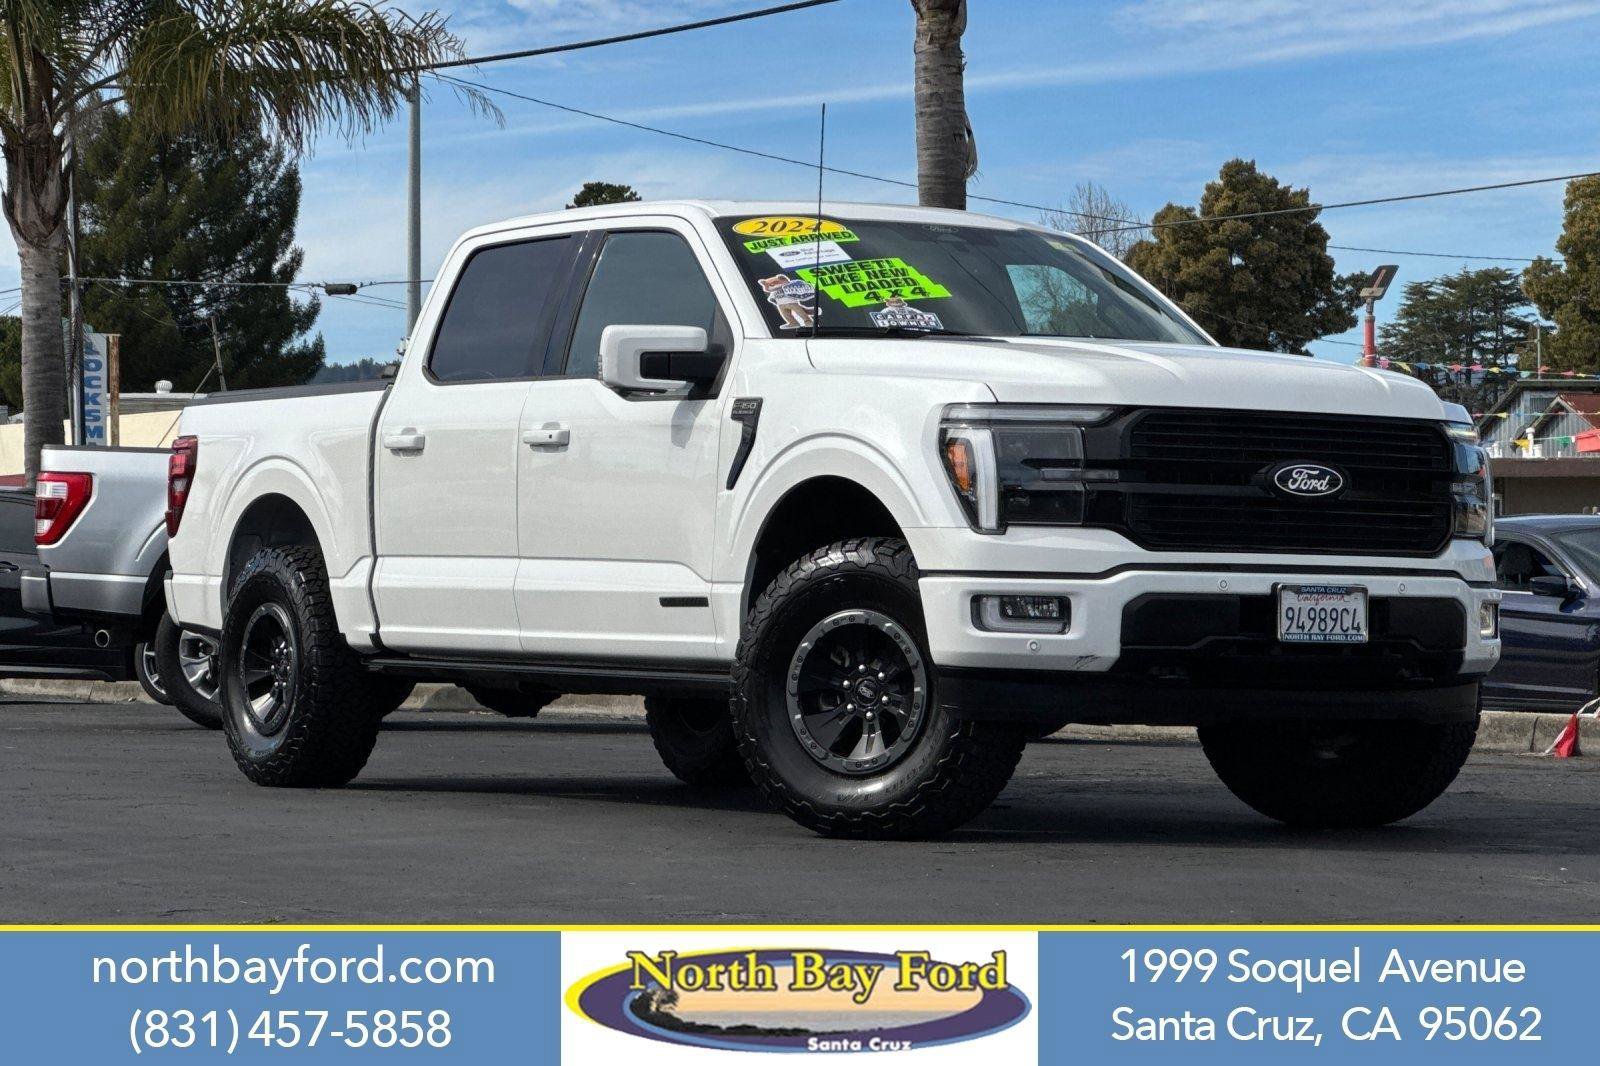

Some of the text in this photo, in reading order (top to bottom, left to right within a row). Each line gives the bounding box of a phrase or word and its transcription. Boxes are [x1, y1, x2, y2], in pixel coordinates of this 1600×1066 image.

[751, 220, 823, 233] 2024
[751, 230, 853, 250] JUST ARRIVED
[808, 259, 893, 276] SWEET!
[818, 266, 908, 287] LIKE NEW
[841, 277, 921, 294] LOADED
[1288, 468, 1330, 491] Ford
[1297, 593, 1348, 605] California
[1285, 606, 1361, 633] 94989C4
[1326, 634, 1364, 642] FORD.COM
